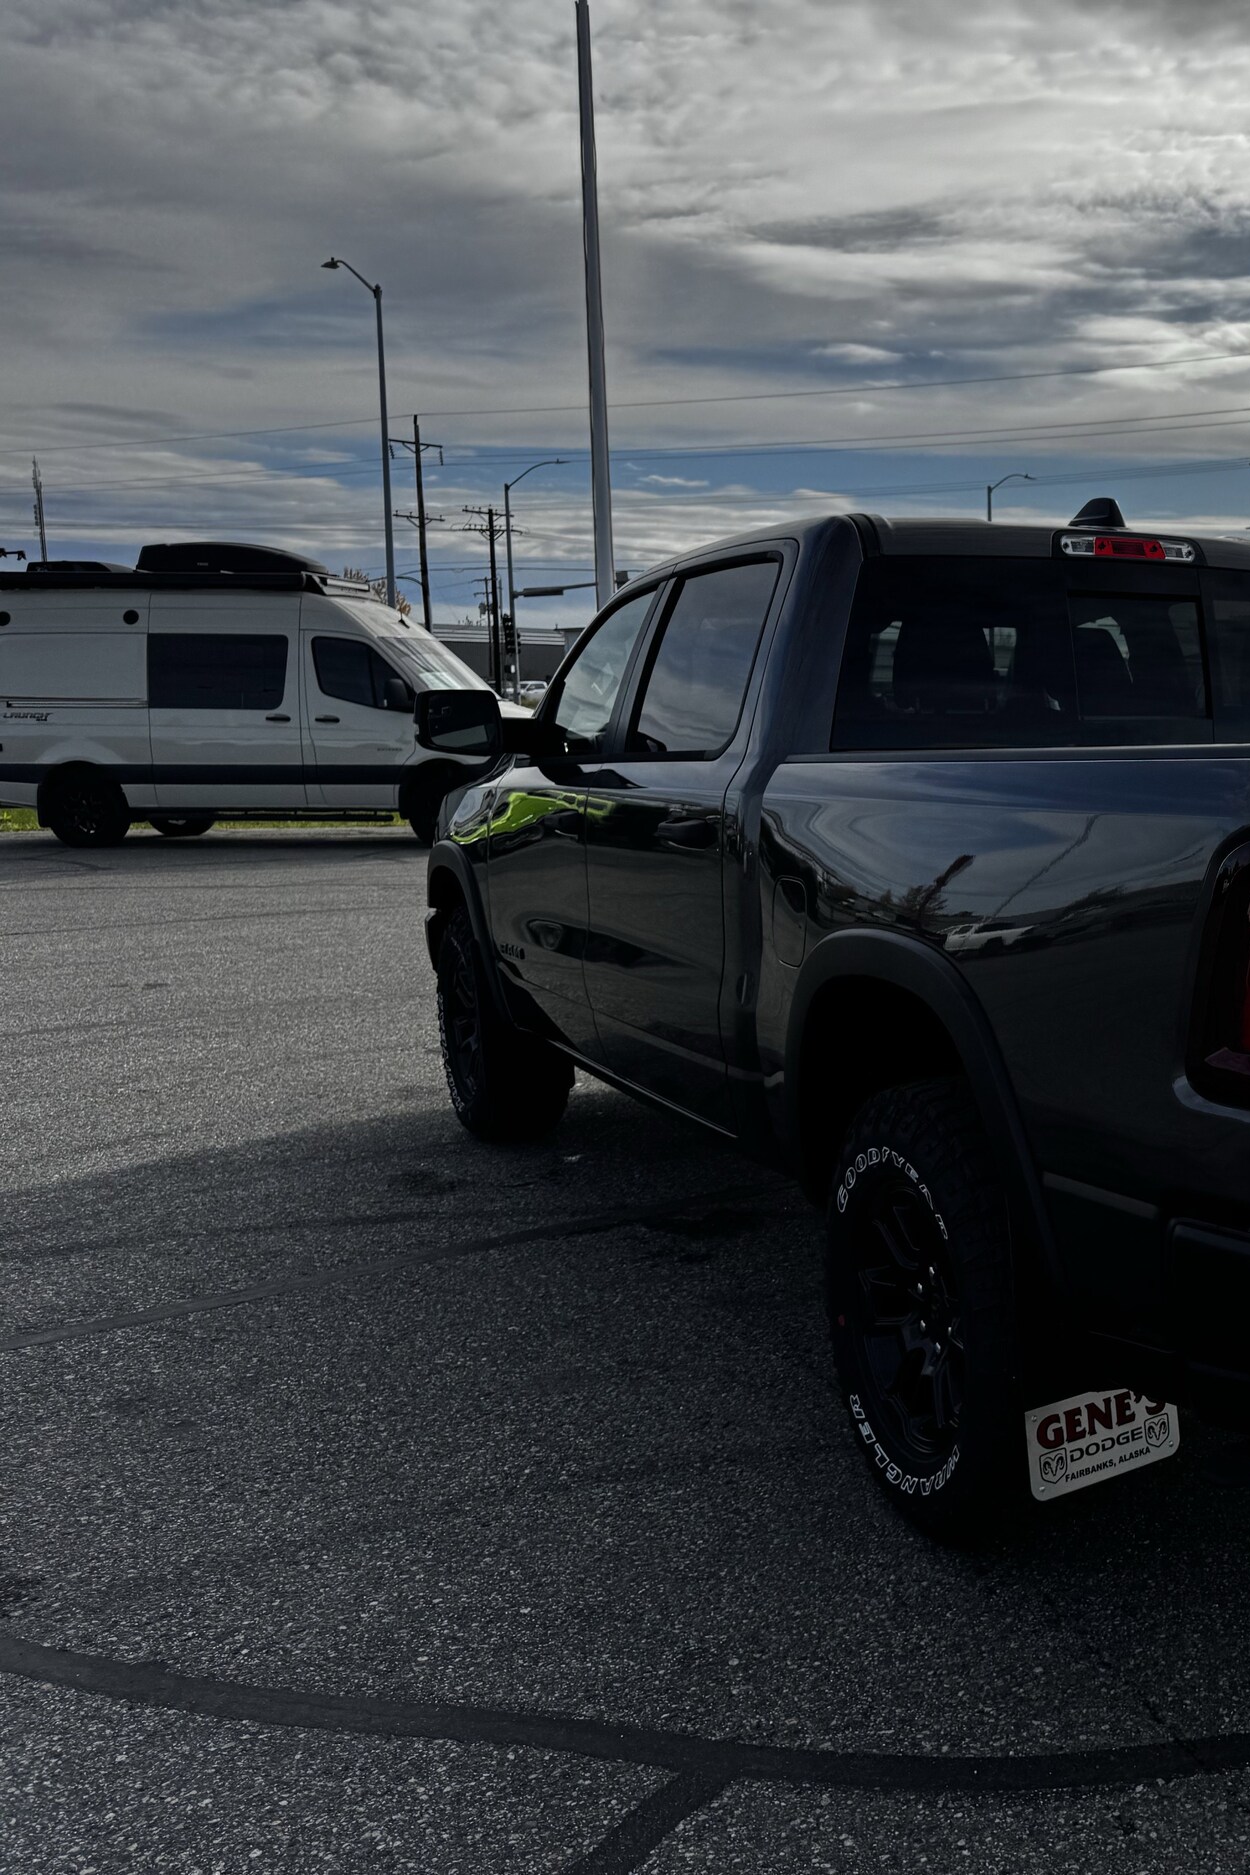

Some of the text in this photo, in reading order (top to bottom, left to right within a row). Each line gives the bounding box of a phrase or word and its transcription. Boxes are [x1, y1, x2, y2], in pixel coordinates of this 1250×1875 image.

[837, 1146, 949, 1240] GOODYEAR
[849, 1394, 960, 1496] WRANGLER
[1065, 1446, 1151, 1482] FAIRBANKS, ALASKA
[1069, 1427, 1143, 1462] DODGE
